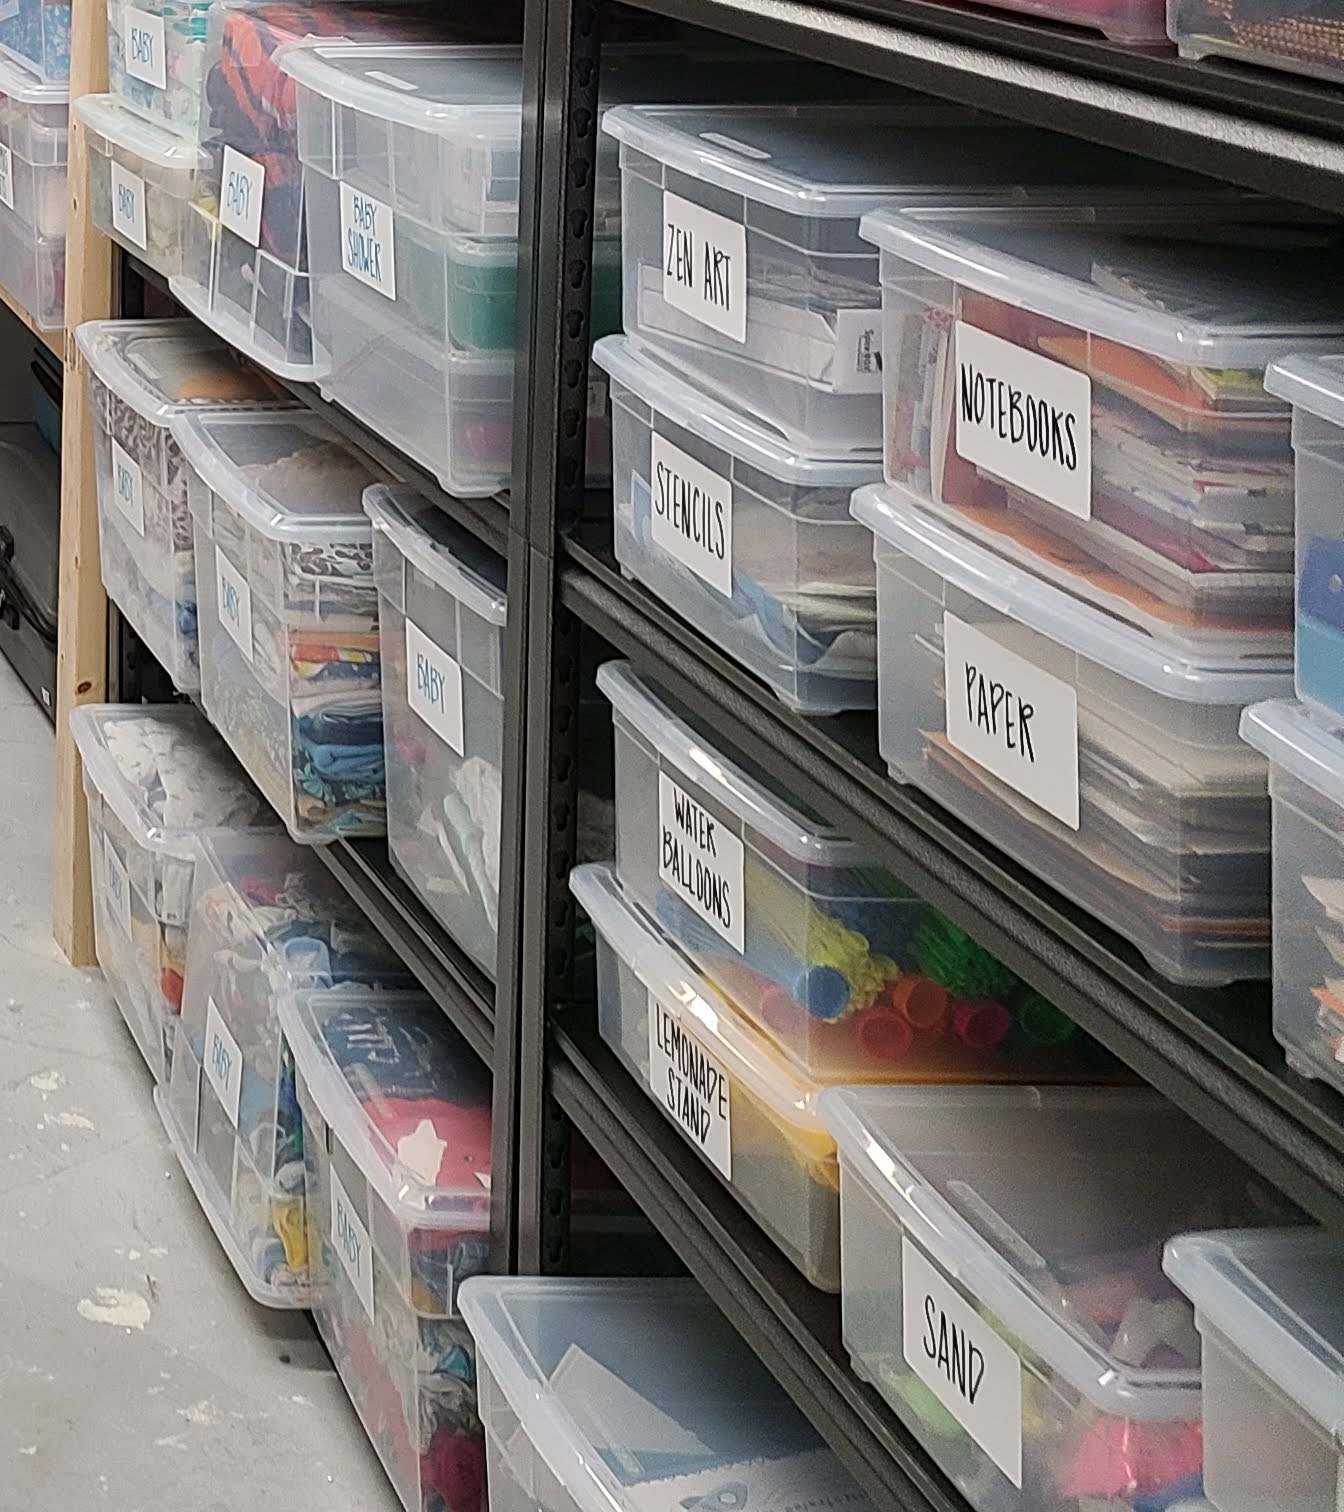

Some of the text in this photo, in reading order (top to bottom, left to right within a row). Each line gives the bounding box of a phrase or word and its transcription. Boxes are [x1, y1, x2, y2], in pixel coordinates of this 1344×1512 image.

[131, 28, 156, 68] BABY
[118, 183, 137, 223] BABY
[226, 172, 253, 222] BABY
[353, 193, 377, 228] BABY
[347, 233, 382, 284] SHOWER
[665, 223, 733, 312] ZEN ART
[960, 361, 1078, 474] NOTEBOOKS
[654, 460, 727, 561] STENCILS
[417, 652, 448, 716] BABY
[964, 661, 1036, 763] PAPER
[672, 786, 718, 859] WATER
[662, 828, 732, 930] BALLOONS
[211, 1031, 235, 1086] BABY
[655, 1005, 729, 1122] LEMONADE
[666, 1074, 712, 1146] STAND
[337, 1198, 365, 1272] BABY
[922, 1293, 986, 1406] SAND
